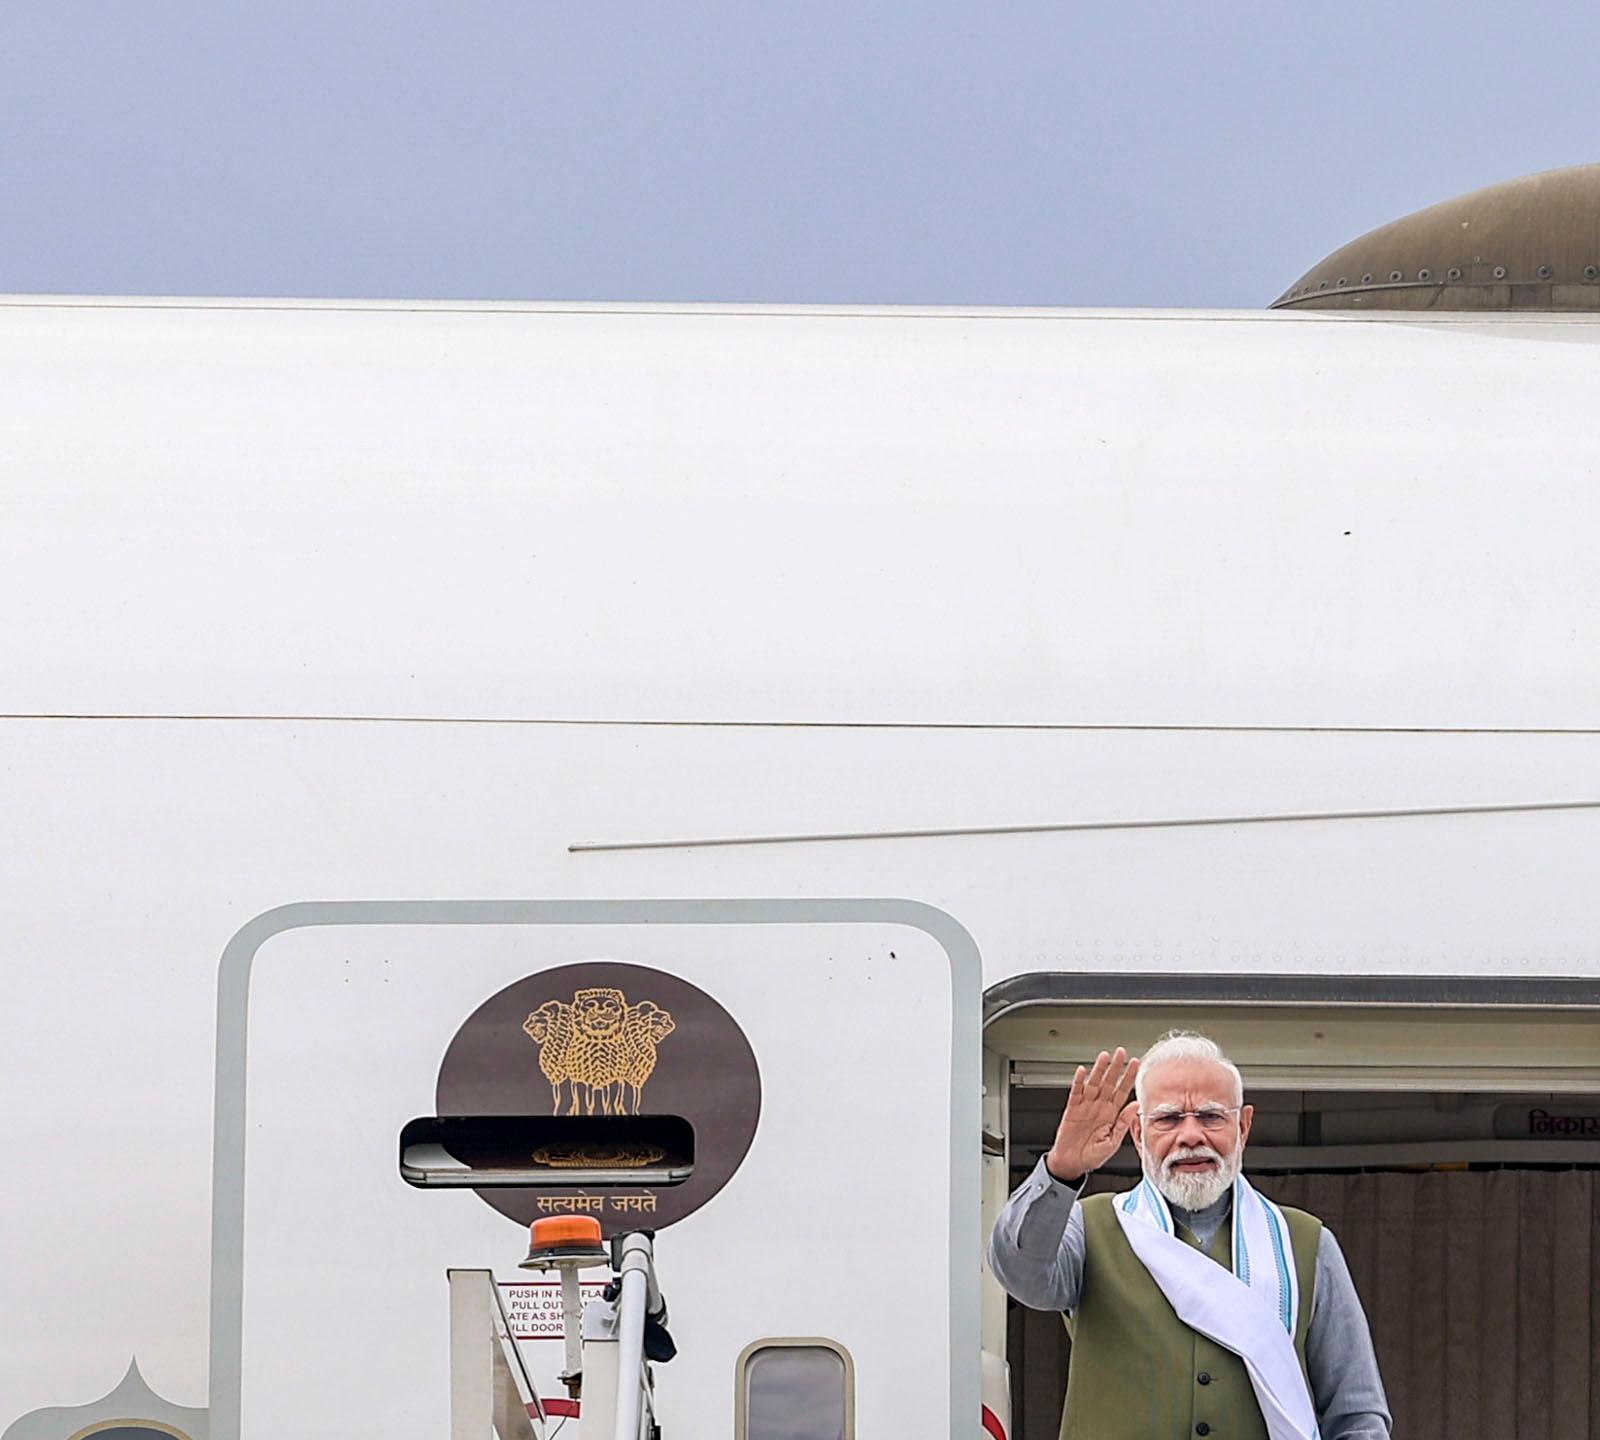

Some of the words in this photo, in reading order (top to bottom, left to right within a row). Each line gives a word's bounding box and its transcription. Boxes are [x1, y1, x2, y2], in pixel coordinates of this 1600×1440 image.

[536, 1189, 605, 1213] सत्यमेव
[610, 1189, 658, 1212] जयते
[509, 1289, 539, 1298] PUSH
[541, 1289, 552, 1298] IN
[581, 1289, 604, 1298] FLA
[512, 1301, 540, 1310] PULL
[531, 1312, 546, 1321] AS
[531, 1323, 563, 1332] DOOR
